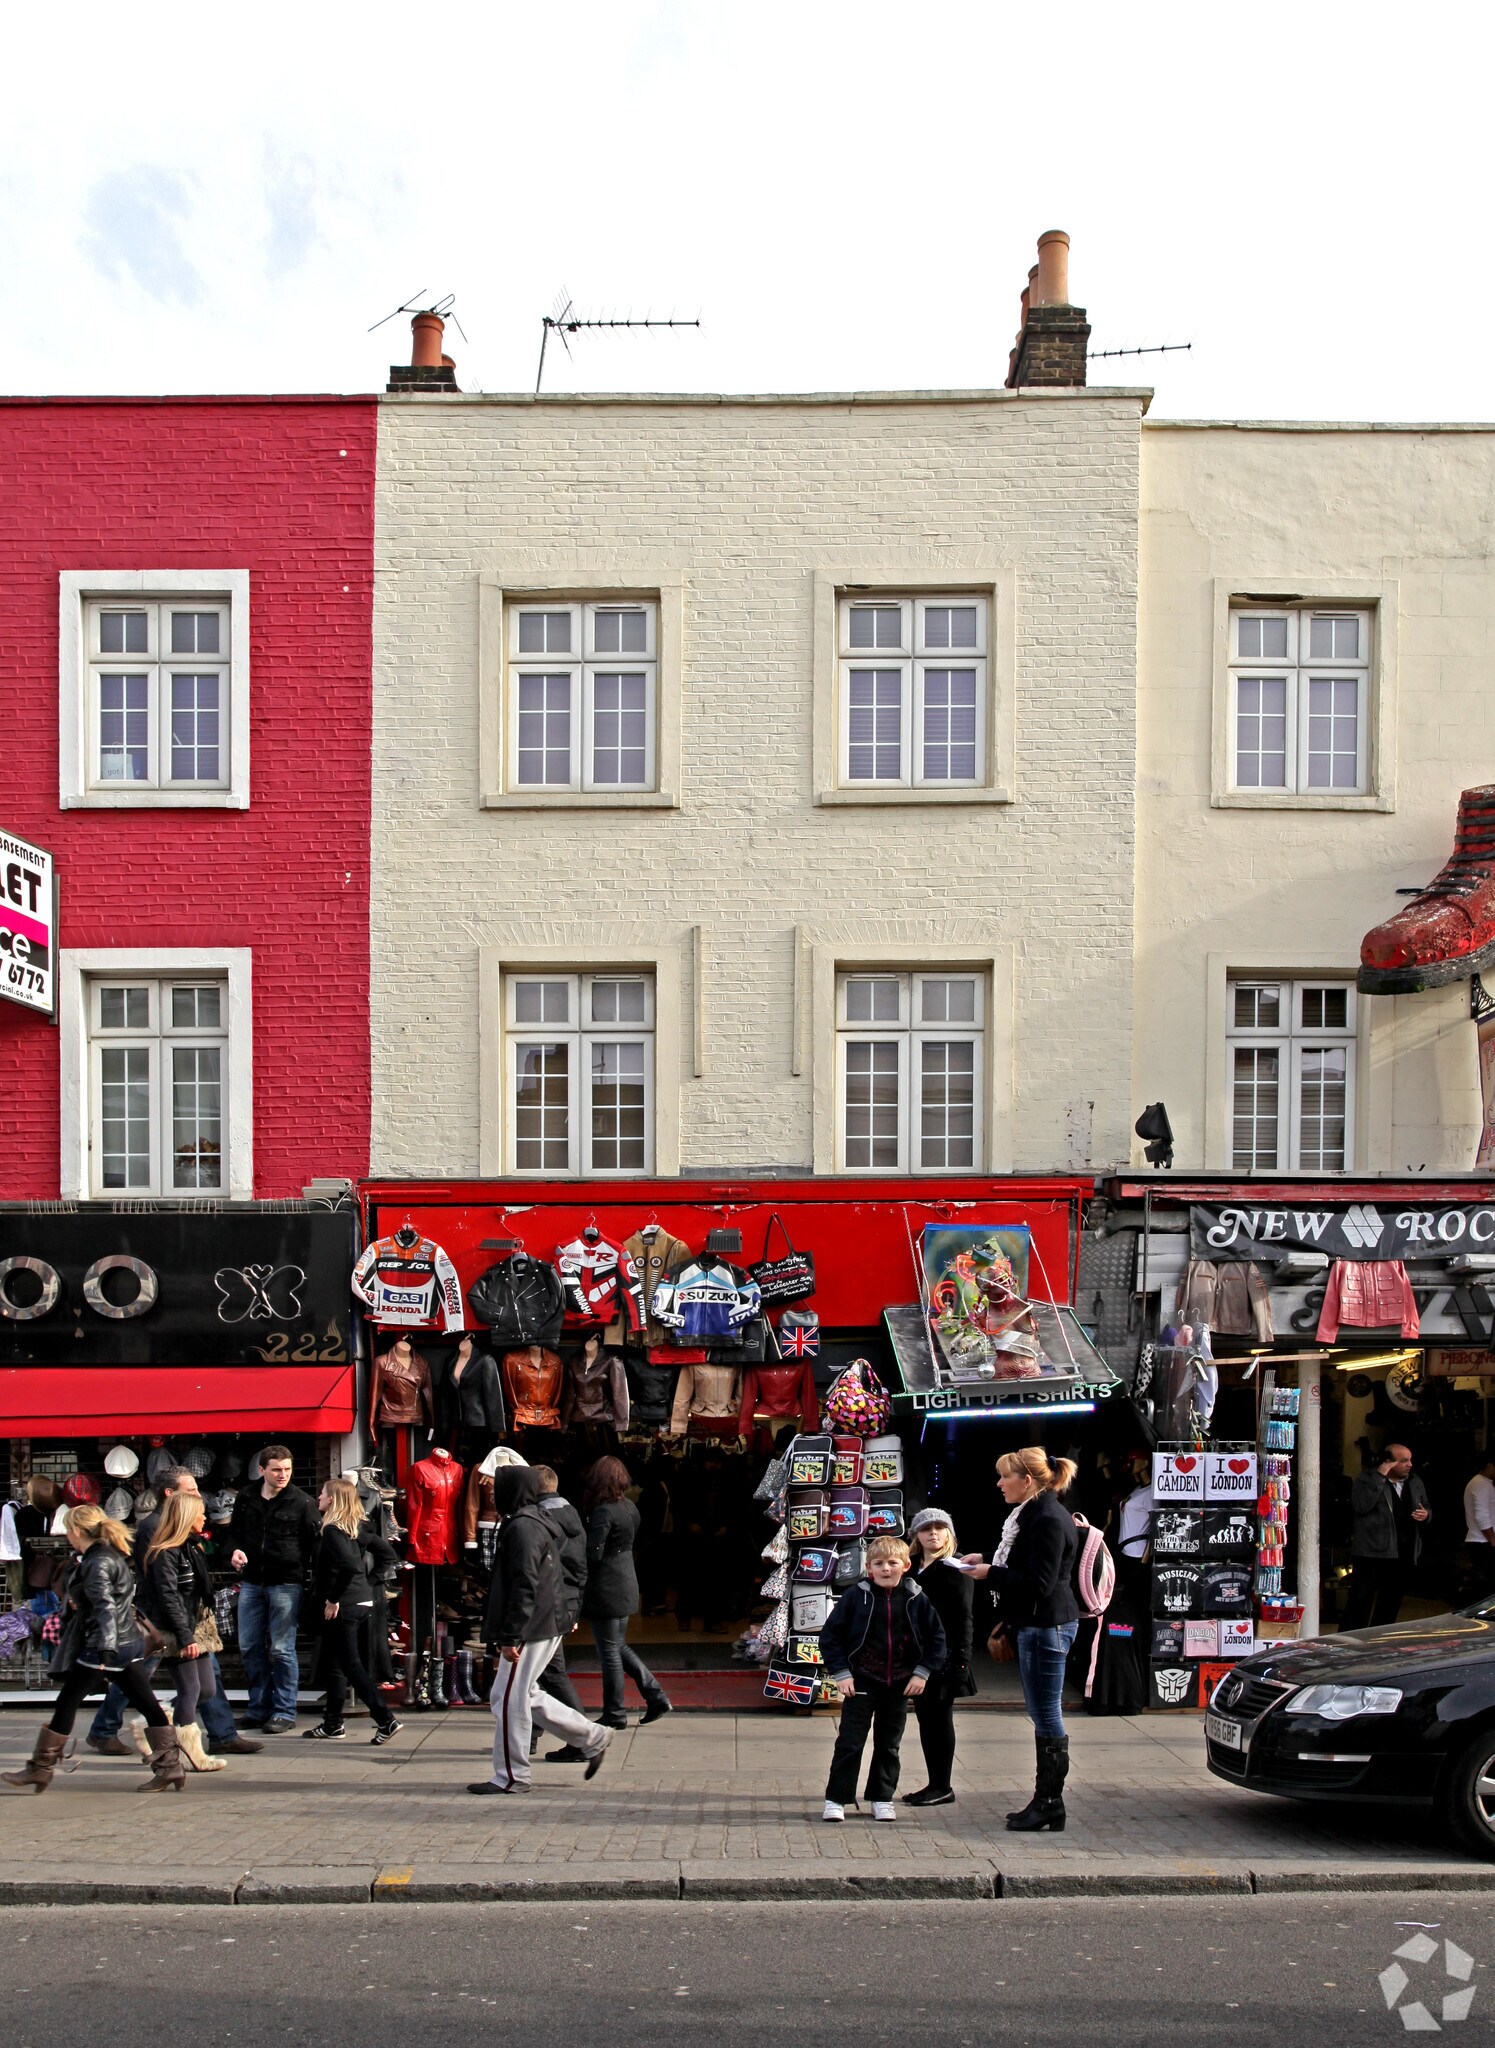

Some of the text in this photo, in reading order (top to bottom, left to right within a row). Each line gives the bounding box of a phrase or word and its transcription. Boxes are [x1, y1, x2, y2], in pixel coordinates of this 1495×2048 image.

[8, 962, 45, 995] 6772
[1206, 1209, 1334, 1248] NEW
[389, 1293, 420, 1303] GAS
[381, 1305, 421, 1315] HONDA
[250, 1317, 347, 1363] 222
[912, 1394, 977, 1410] LIGHT
[1163, 1456, 1173, 1473] I
[1216, 1458, 1225, 1473] I
[1157, 1474, 1200, 1492] CAMDEN
[1211, 1475, 1253, 1490] LONDON
[1186, 1627, 1216, 1640] LONDON
[1227, 1625, 1234, 1635] I
[1224, 1635, 1252, 1645] LONDON
[1221, 1722, 1238, 1744] GBF
